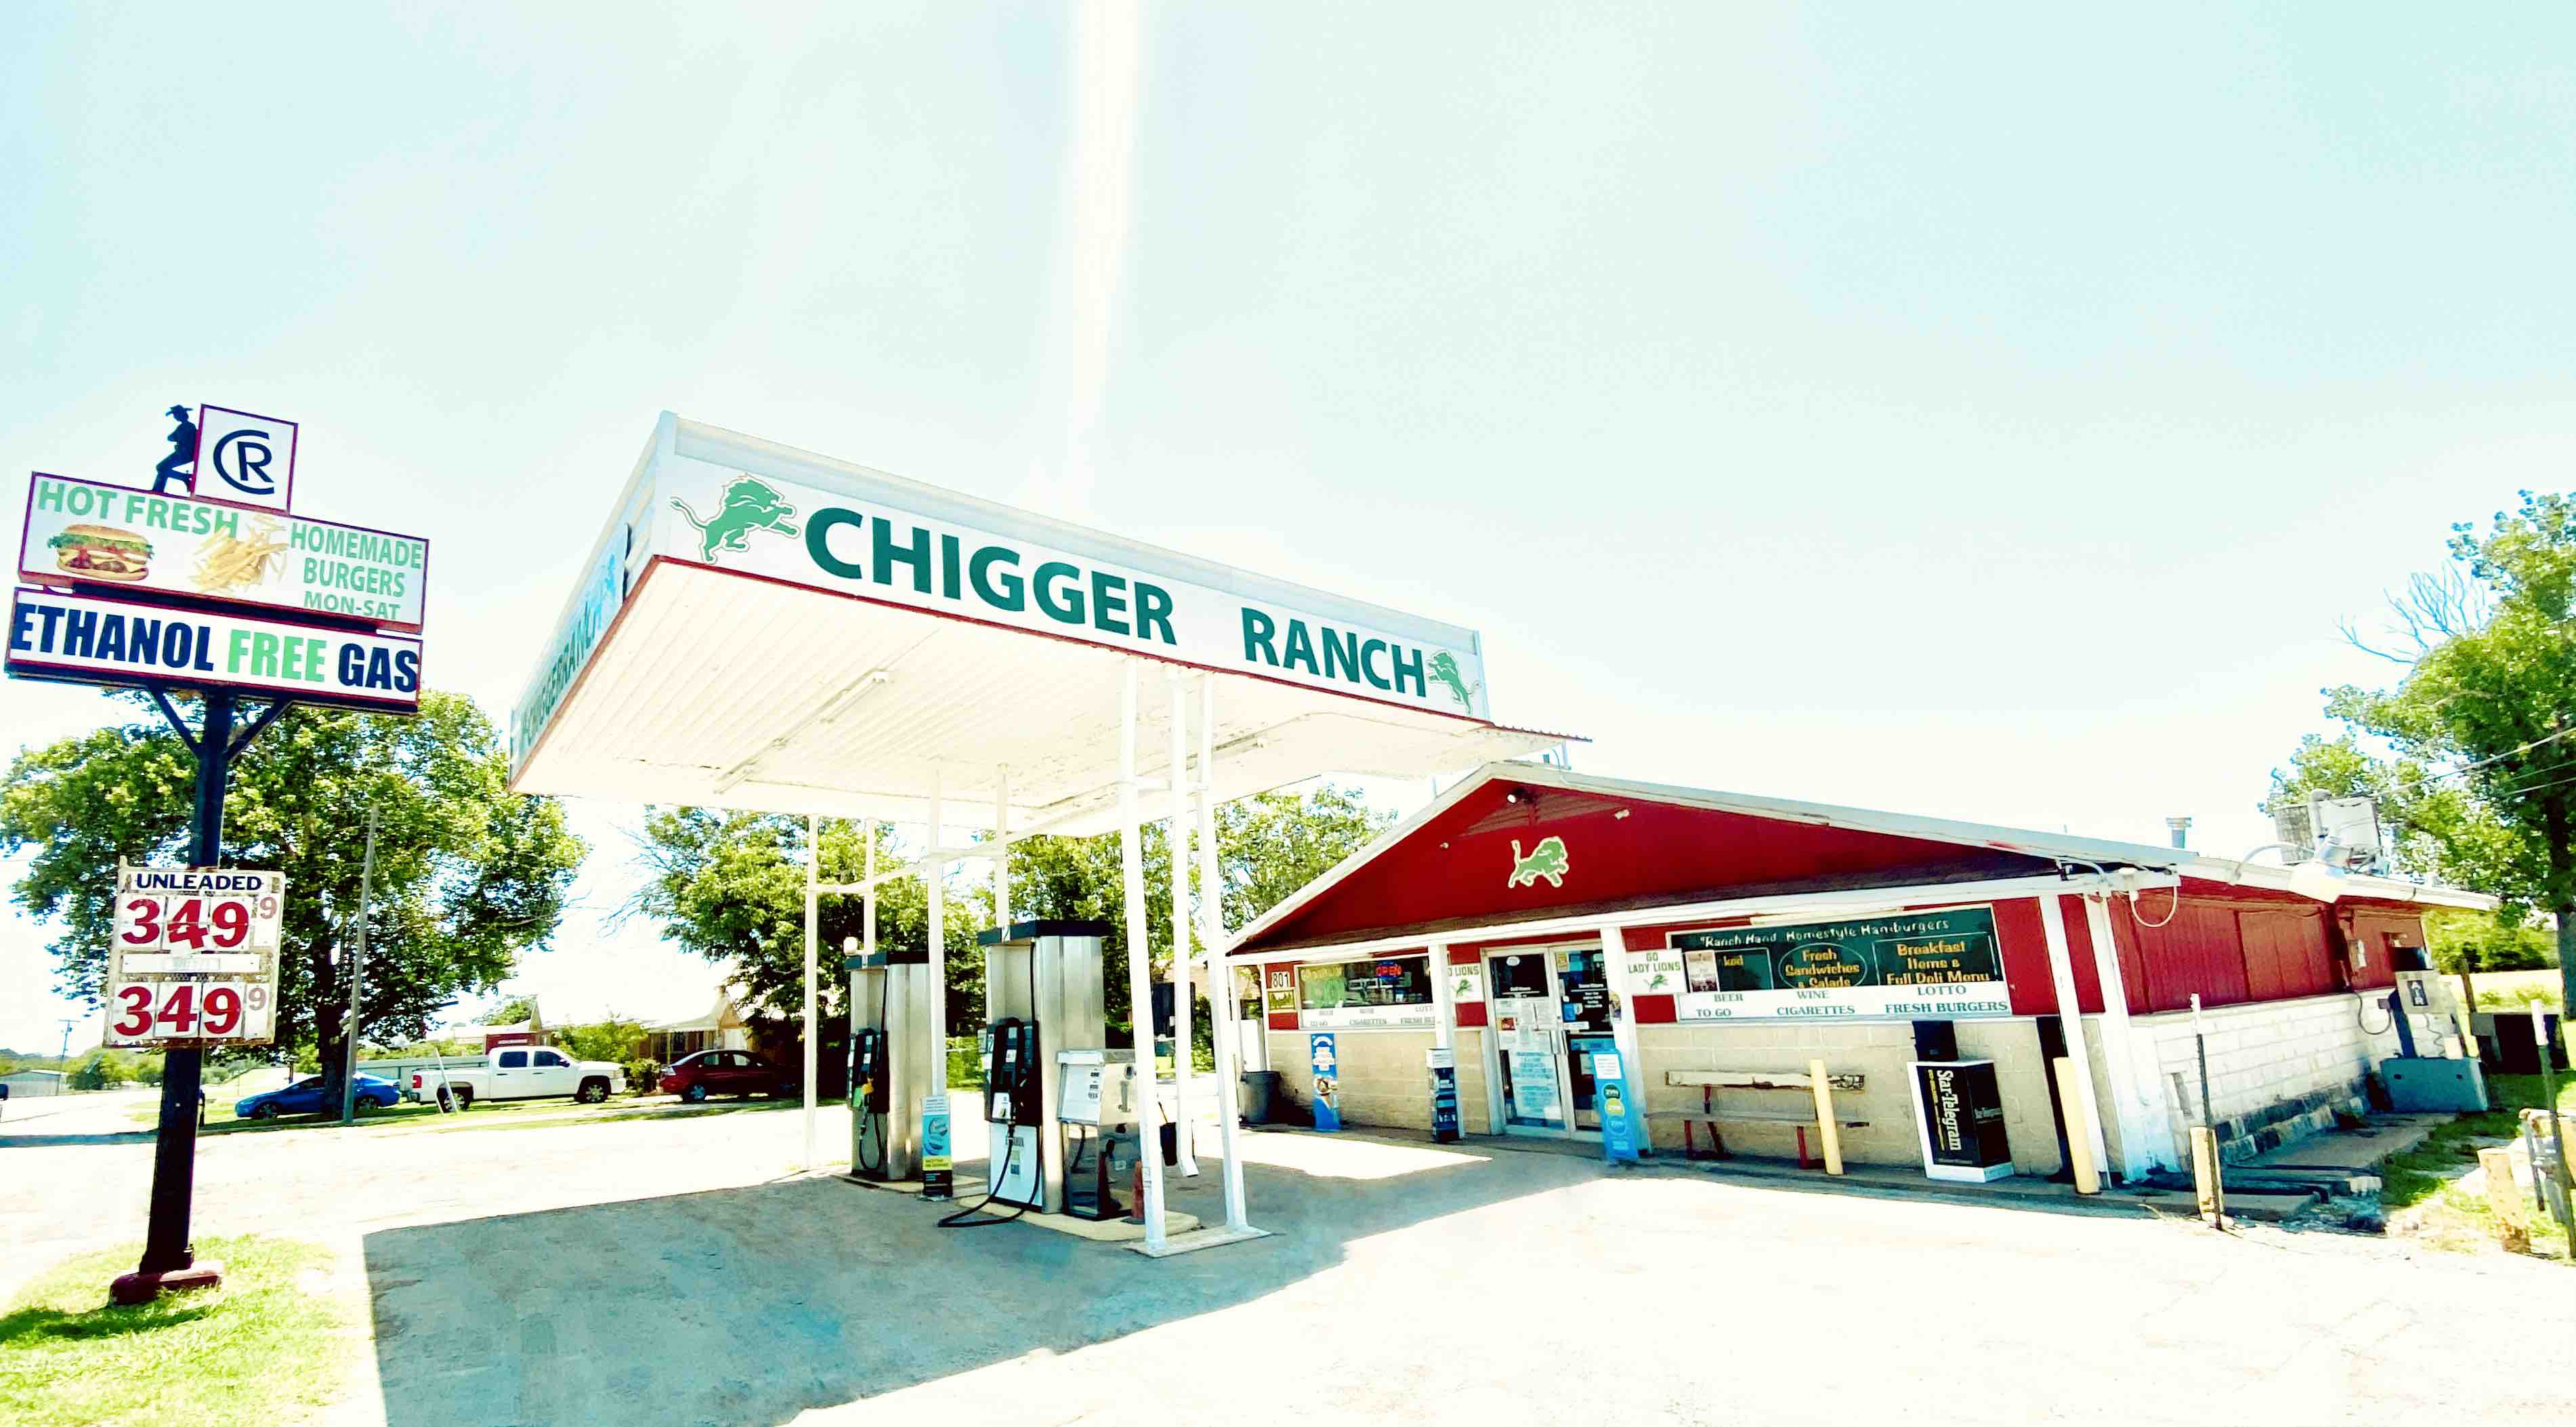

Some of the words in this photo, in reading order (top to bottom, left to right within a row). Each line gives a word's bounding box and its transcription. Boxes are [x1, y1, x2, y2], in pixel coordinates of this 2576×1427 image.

[38, 480, 119, 519] HOT
[125, 495, 239, 539] FRESH
[291, 522, 423, 569] HOMEMADE
[303, 557, 405, 598] BURGERS
[303, 591, 400, 620] MON-SAT
[805, 507, 1177, 646] CHIGGER
[1241, 607, 1427, 697] RANCH
[9, 602, 214, 671] ETHANOL
[227, 629, 327, 683] FREE
[338, 642, 419, 692] GAS
[136, 873, 262, 890] UNLEADED
[121, 898, 249, 949] 349
[259, 896, 278, 919] 9
[1745, 932, 1777, 945] Hand
[1786, 926, 1857, 941] Homestyle
[1860, 919, 1949, 936] Hamburgers
[1647, 952, 1658, 961] GO
[1802, 948, 1837, 961] Fresh
[1897, 940, 1965, 956] Breakfast
[1376, 964, 1403, 977] OPEN
[1455, 966, 1480, 976] LIONS
[1628, 964, 1649, 974] LADY
[1653, 961, 1681, 972] LIONS
[1785, 961, 1860, 976] Sandwiches
[1907, 958, 1947, 970] Items
[1809, 976, 1851, 987] Salads
[1886, 972, 1912, 985] Full
[1916, 972, 1943, 983] Deli
[1947, 970, 1990, 982] Menu
[1714, 993, 1744, 1002] BEER
[1796, 991, 1830, 999] WINE
[1917, 985, 1966, 995] LOTTO
[113, 986, 242, 1037] 349
[248, 987, 267, 1011] 9
[1696, 1008, 1711, 1017] TO
[1715, 1008, 1731, 1017] GO
[1777, 1005, 1855, 1015] CIGARETTES
[1886, 1003, 1931, 1013] FRESH
[1936, 1001, 2008, 1012] BURGERS
[1937, 1069, 1962, 1151] Star-Telegram
